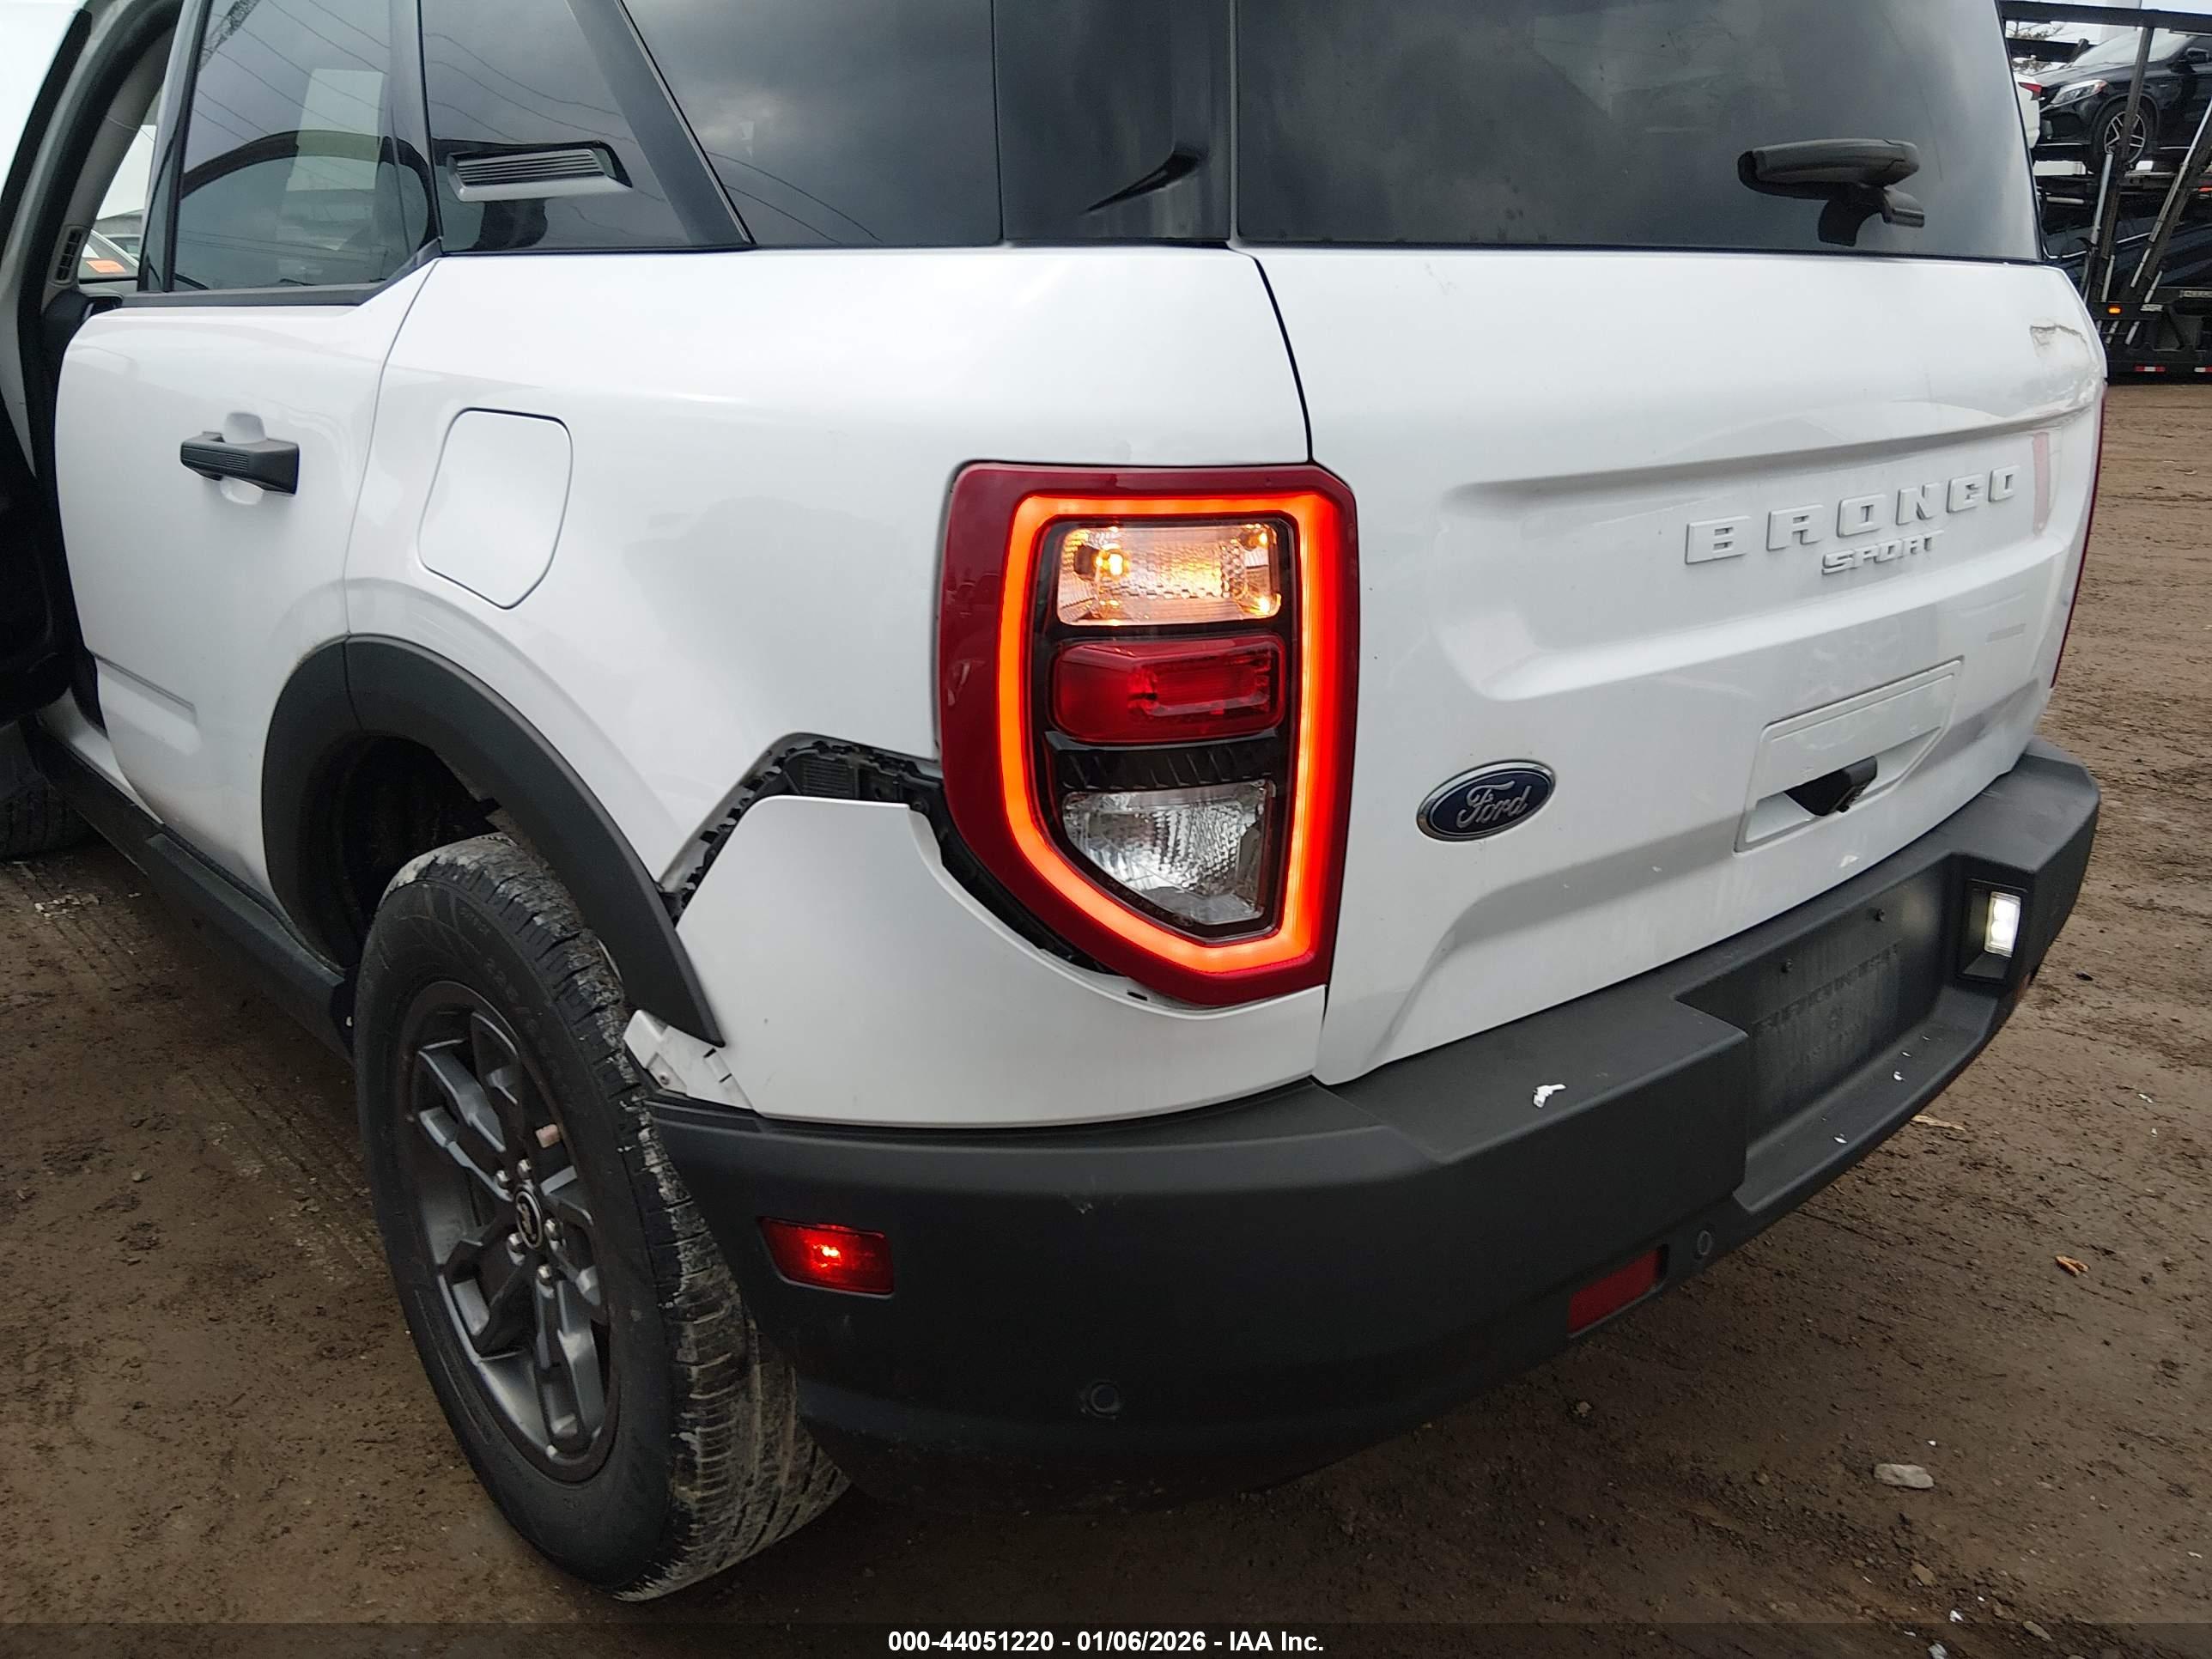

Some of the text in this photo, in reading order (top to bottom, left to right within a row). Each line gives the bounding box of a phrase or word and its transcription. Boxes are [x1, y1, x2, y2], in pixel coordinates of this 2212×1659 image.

[1686, 465, 2018, 564] BRONCO
[1821, 531, 1942, 574] SPORT
[1456, 781, 1531, 829] Ford
